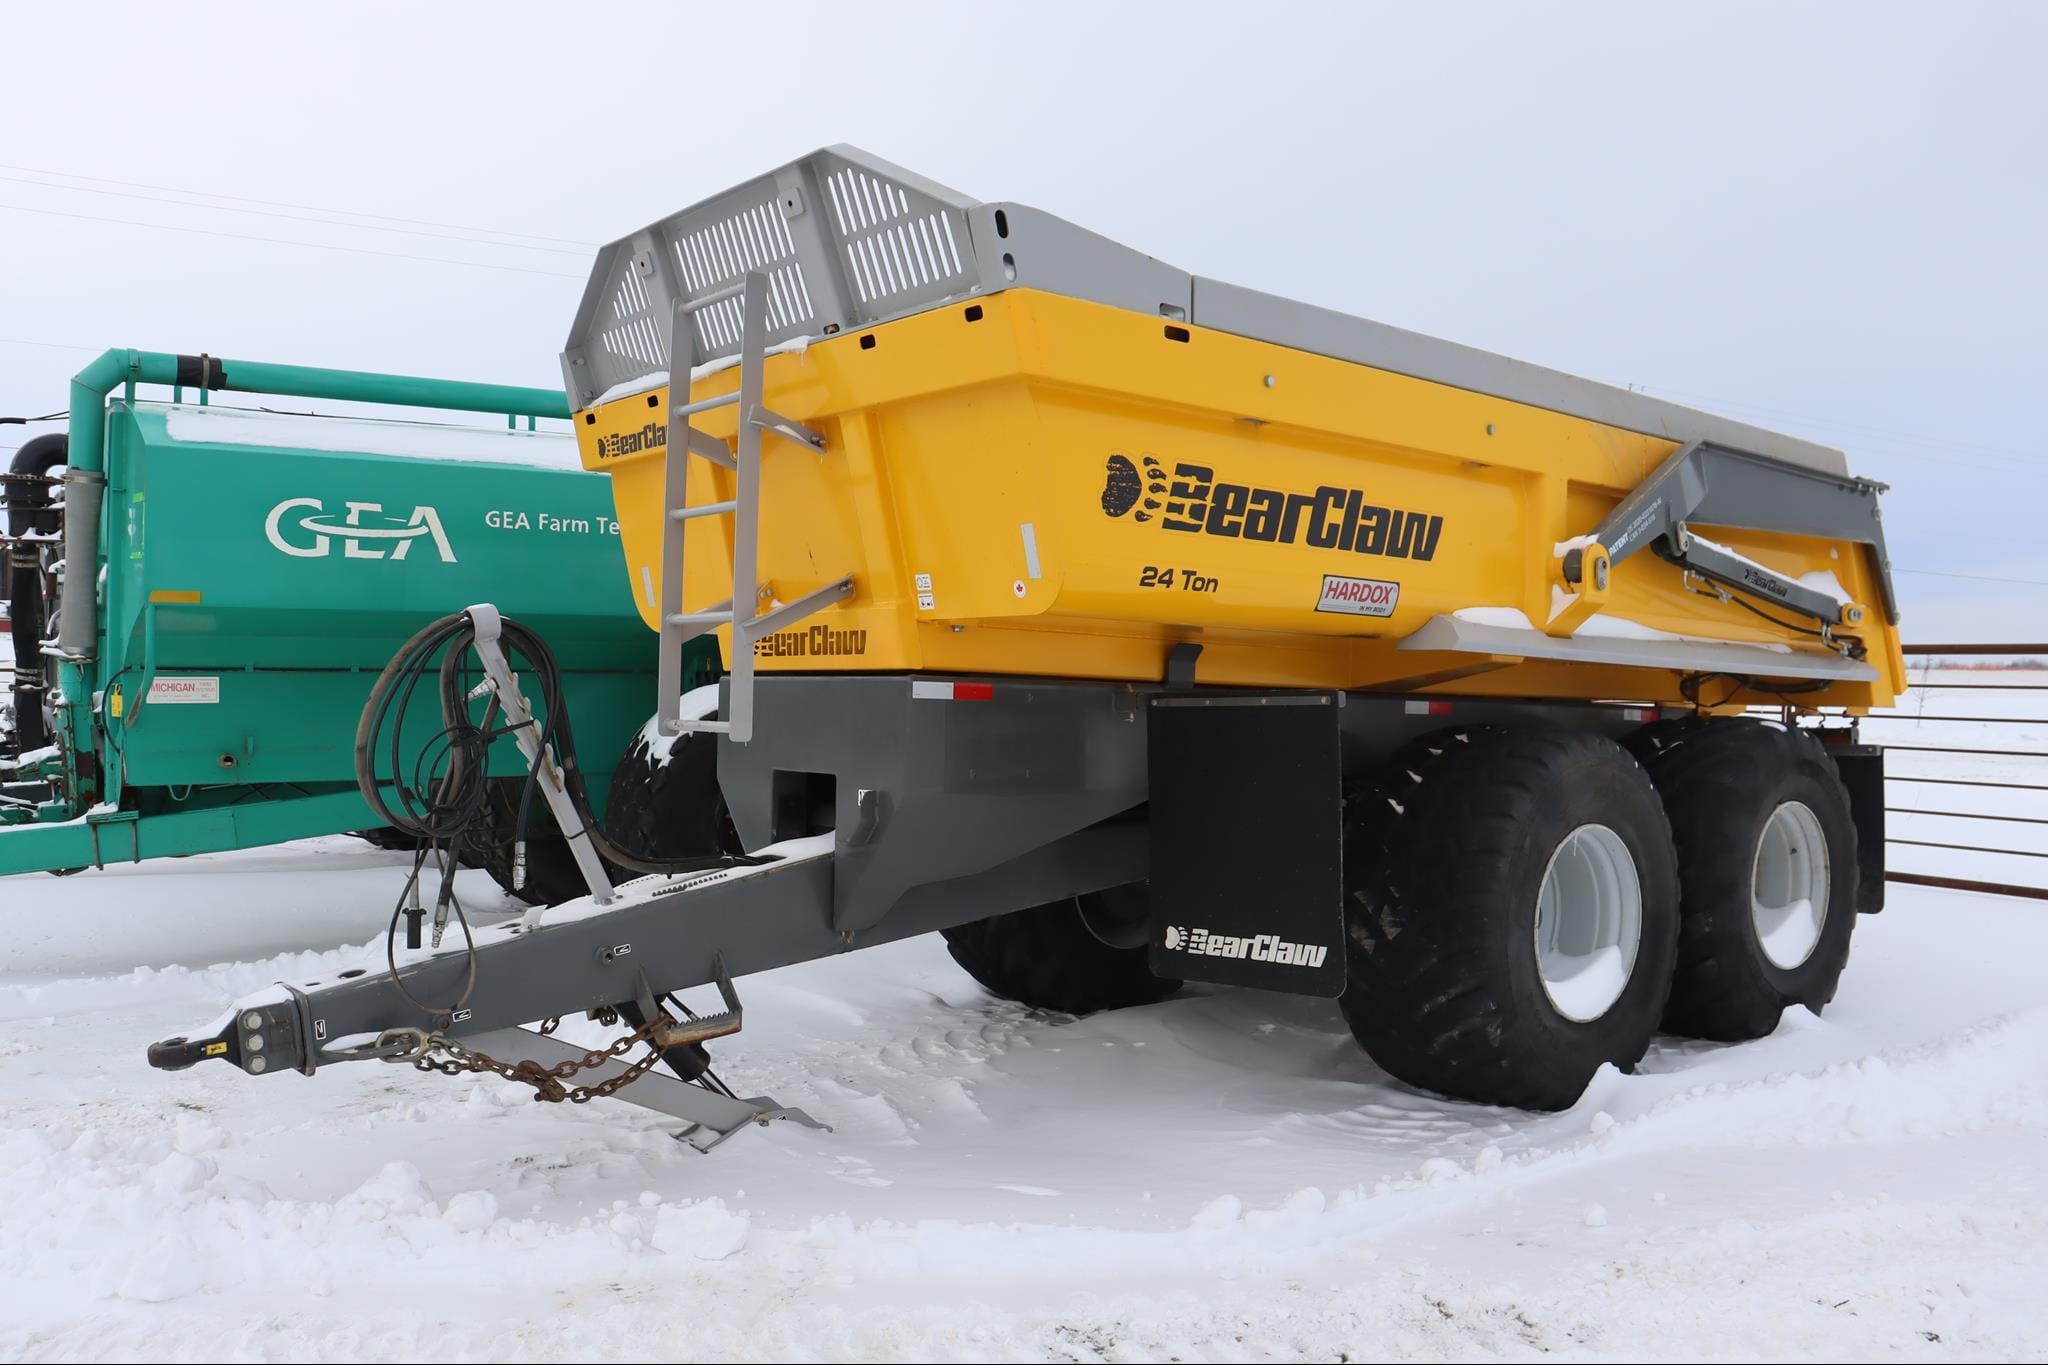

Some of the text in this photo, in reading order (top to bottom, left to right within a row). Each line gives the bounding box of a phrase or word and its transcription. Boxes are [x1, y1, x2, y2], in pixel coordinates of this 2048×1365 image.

[611, 423, 668, 458] BearCla
[485, 511, 531, 530] GEA
[539, 513, 589, 534] Farm
[1162, 463, 1444, 562] BearClaw
[265, 498, 458, 563] GEA
[1139, 566, 1219, 593] 24 Ton
[1324, 580, 1394, 605] HARDOX
[1188, 928, 1328, 968] BearClaw
